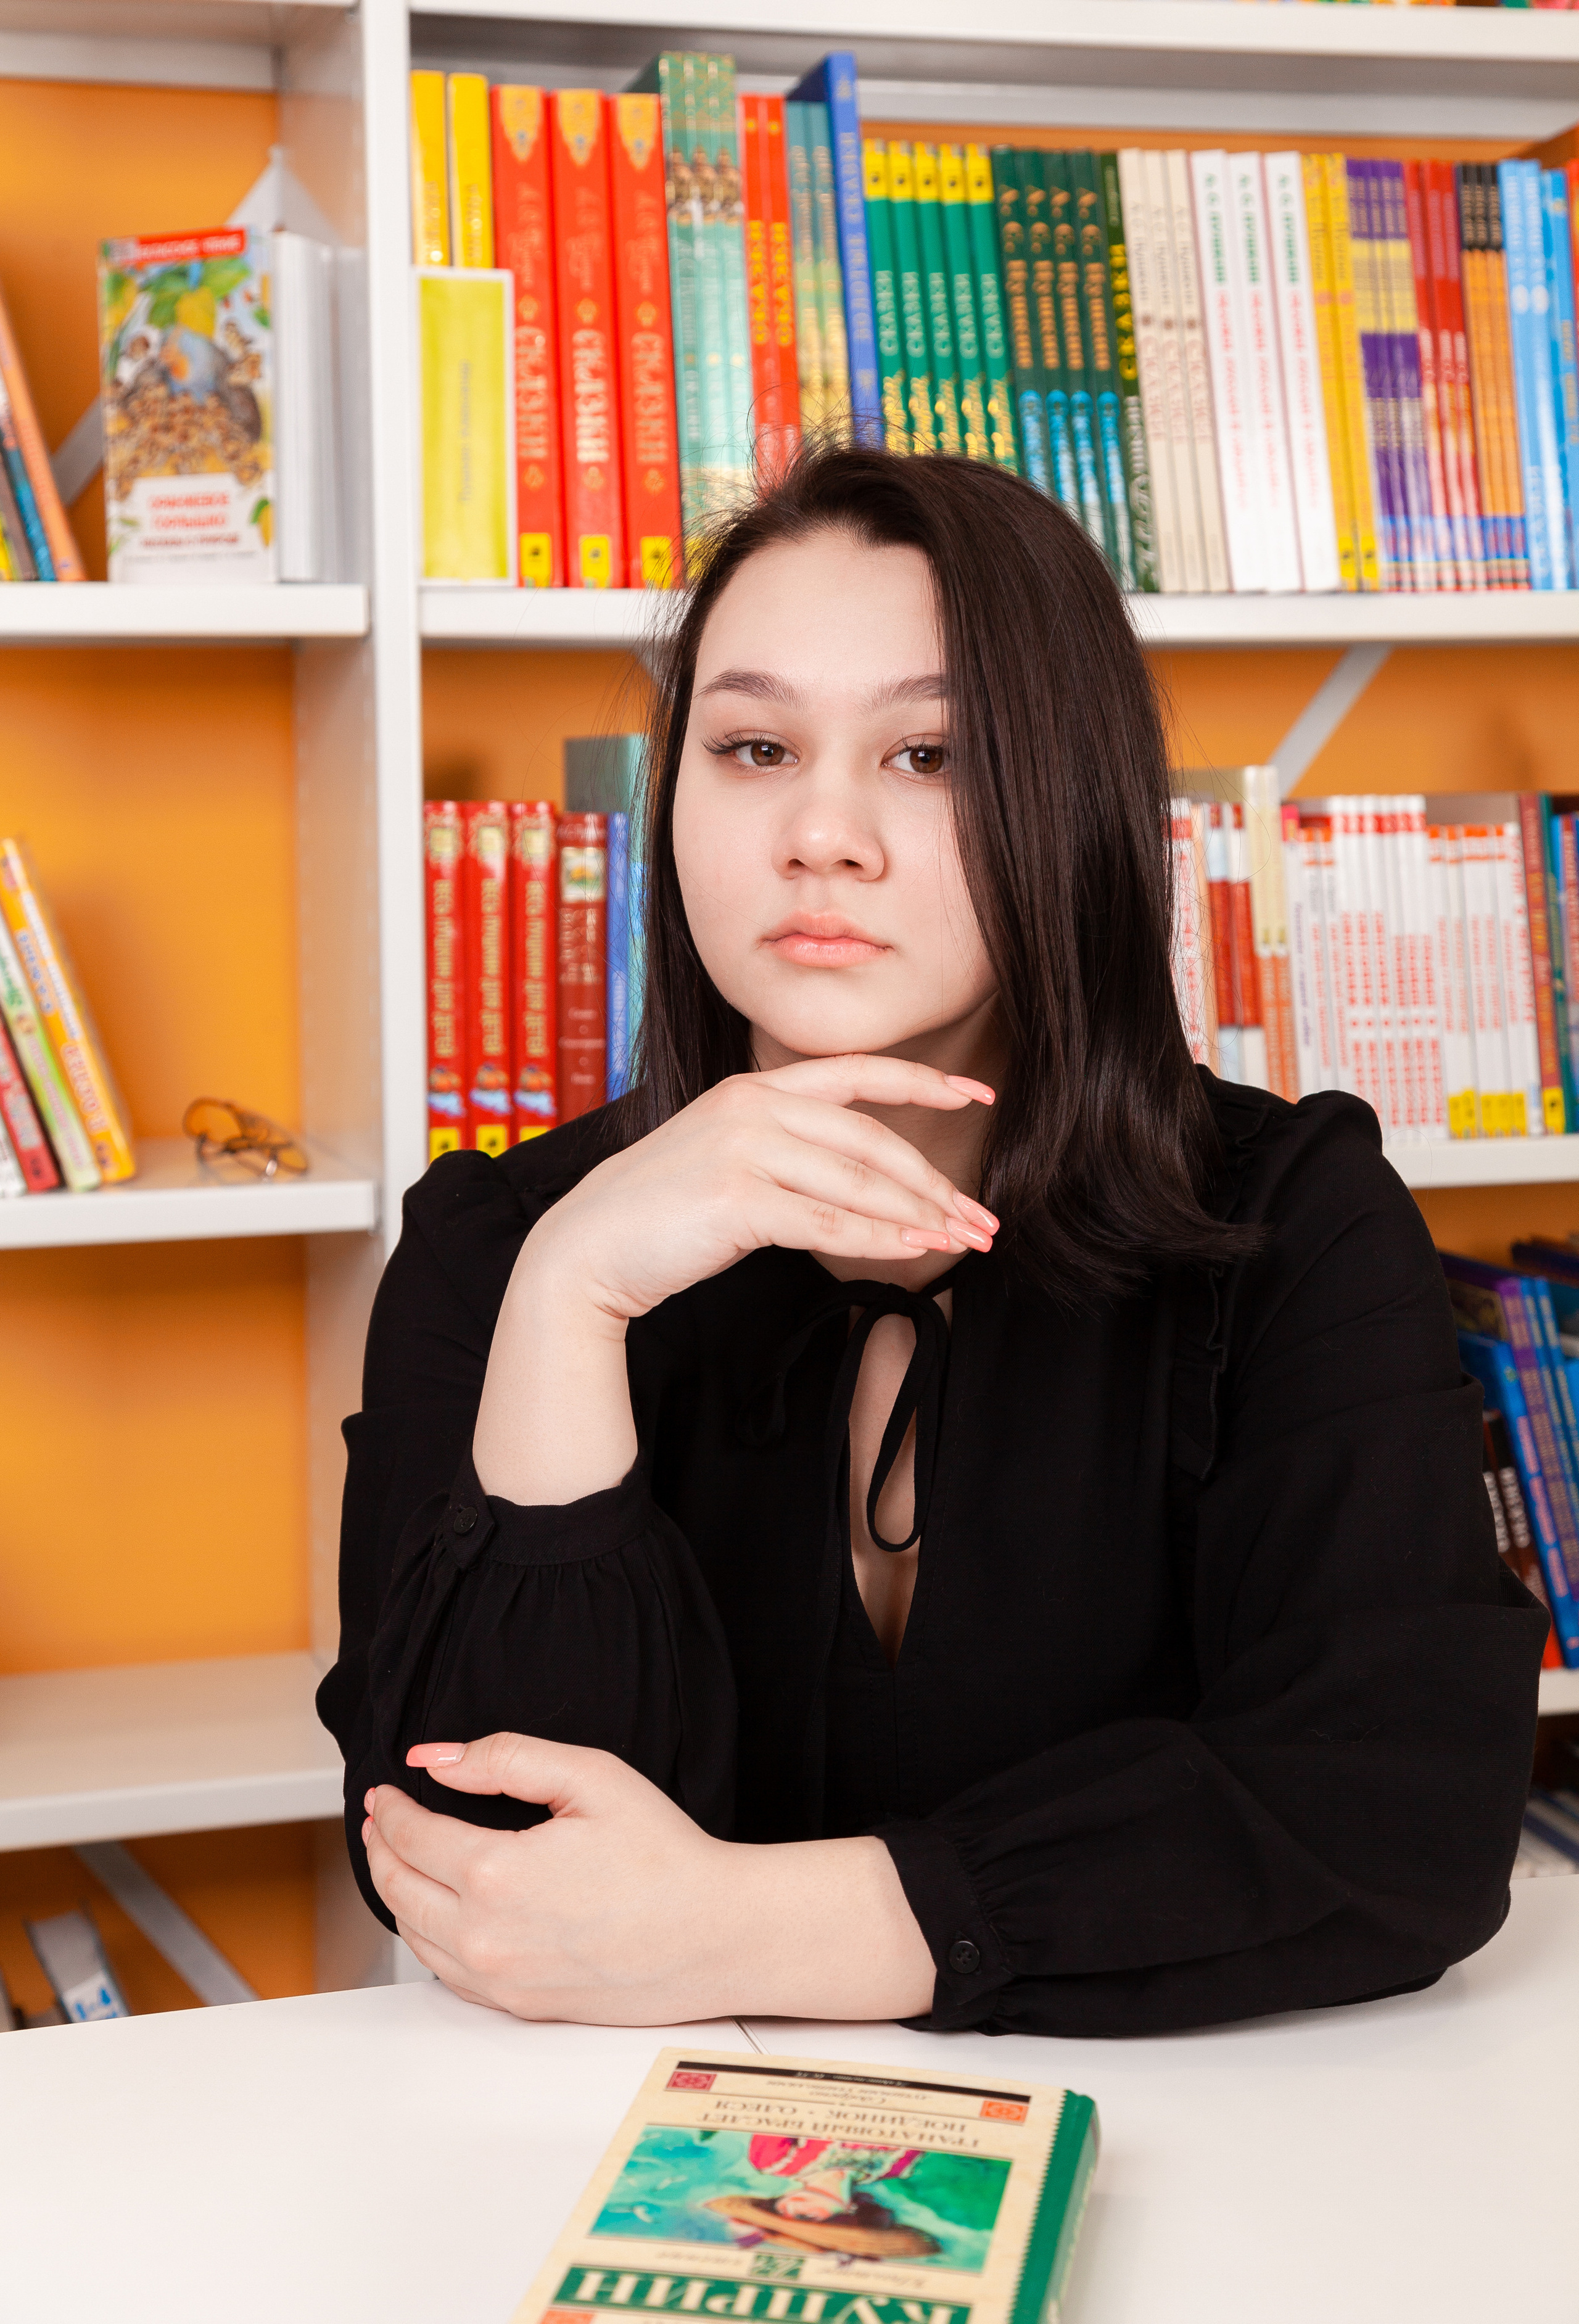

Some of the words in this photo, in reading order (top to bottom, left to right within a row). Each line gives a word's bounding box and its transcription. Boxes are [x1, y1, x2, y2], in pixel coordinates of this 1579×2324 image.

[1206, 212, 1227, 286] ПУШКИН
[1241, 212, 1261, 286] ПУШКИН
[1281, 212, 1301, 286] ПУШКИН
[875, 270, 899, 357] СКАЗКИ
[902, 272, 925, 358] СКАЗКИ
[928, 273, 952, 358] СКАЗКИ
[954, 273, 978, 359] СКАЗКИ
[981, 273, 1004, 359] СКАЗКИ
[1110, 244, 1137, 381] СКАЗКИ
[514, 324, 550, 459] СКАЗКИ
[571, 328, 610, 463] СКАЗКИ
[630, 331, 668, 464] СКАЗКИ
[1139, 336, 1165, 442] СКАЗКИ
[1160, 339, 1187, 445] СКАЗКИ
[1185, 339, 1211, 445] СКАЗКИ
[696, 2111, 804, 2130] БРАСЛЕТ
[714, 2100, 798, 2116] ОЛЕСЯ
[811, 2122, 979, 2148] ГРАНАТОВЫЙ
[826, 2109, 967, 2133] ПОЕДИНОК
